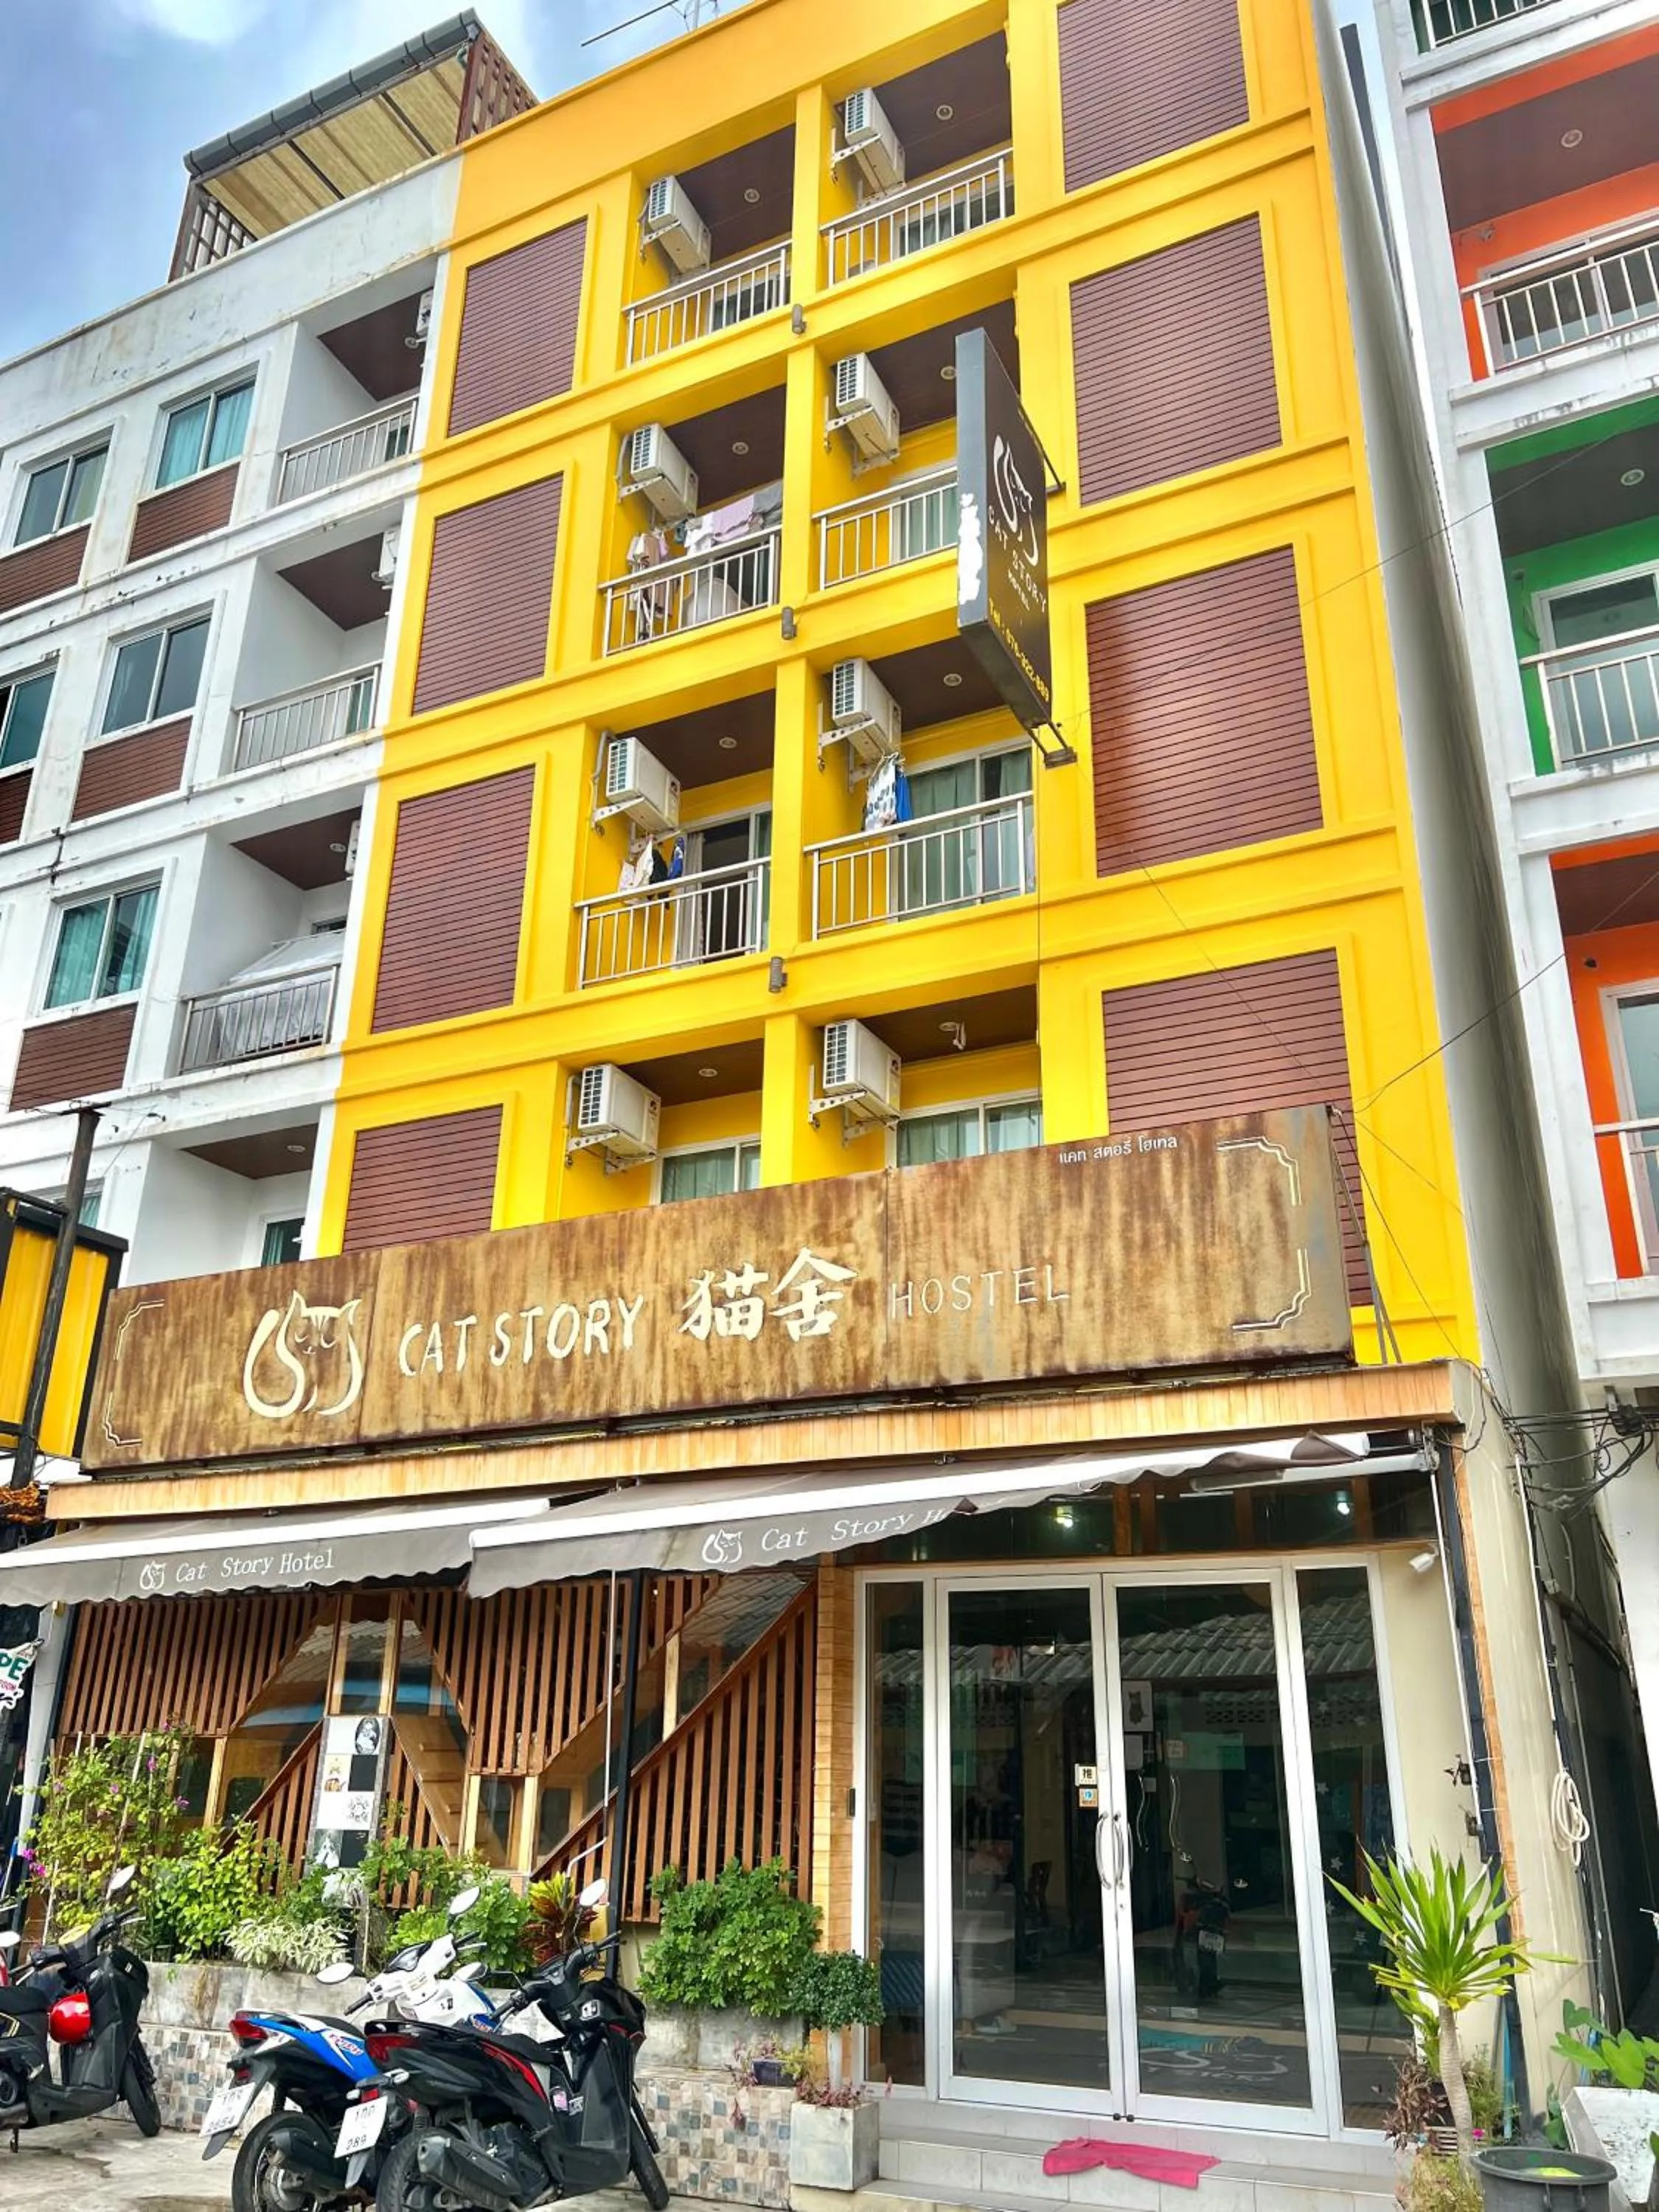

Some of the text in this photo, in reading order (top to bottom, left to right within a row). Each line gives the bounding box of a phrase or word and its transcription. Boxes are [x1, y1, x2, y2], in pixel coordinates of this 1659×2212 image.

[989, 505, 1046, 613] CAT STORY
[1060, 1150, 1086, 1164] แคท
[678, 1246, 858, 1342] 猫舍
[891, 1264, 1070, 1319] HOSTEL
[399, 1294, 644, 1377] CAT STORY
[761, 1528, 809, 1551] Cat
[830, 1512, 914, 1542] Story
[176, 1548, 334, 1582] Cat Story Hotel
